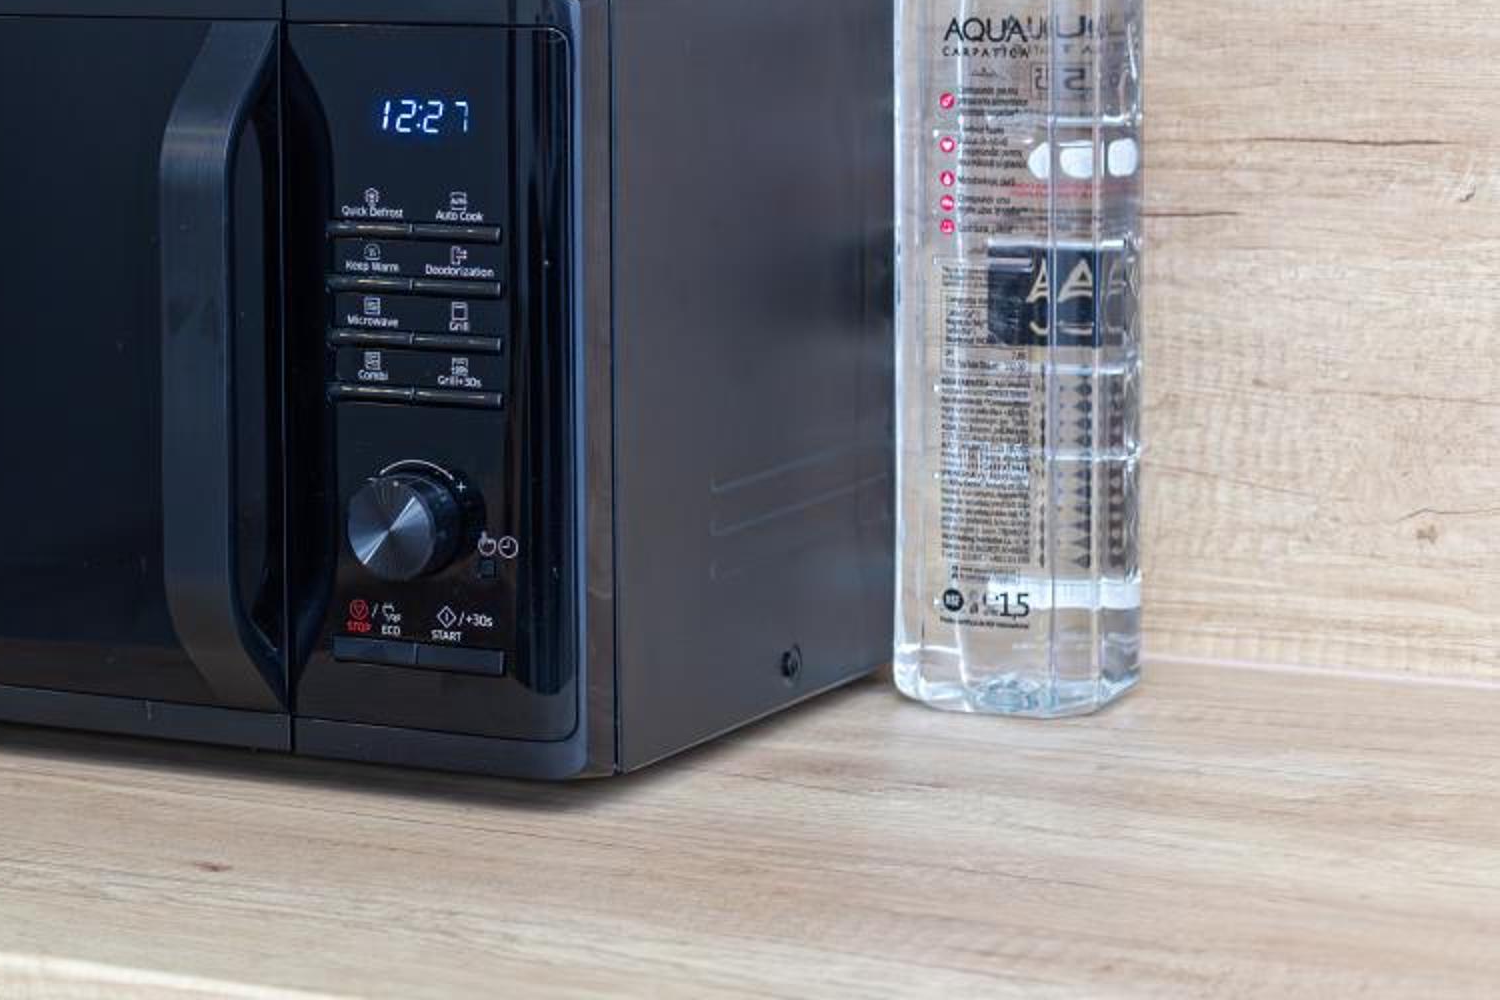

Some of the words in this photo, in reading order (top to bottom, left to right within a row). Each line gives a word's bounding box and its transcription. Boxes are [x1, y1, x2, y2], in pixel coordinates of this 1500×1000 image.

[943, 16, 1029, 43] AQUA
[381, 100, 469, 133] 12:27
[341, 205, 368, 218] Quick
[369, 206, 404, 219] Defrost
[436, 210, 458, 221] Auto
[459, 211, 484, 222] Cook
[345, 260, 369, 273] Keep
[425, 264, 495, 278] Deodorization
[347, 314, 399, 328] Microwave
[346, 621, 372, 633] STOP
[381, 625, 401, 636] ECO
[431, 630, 463, 642] START
